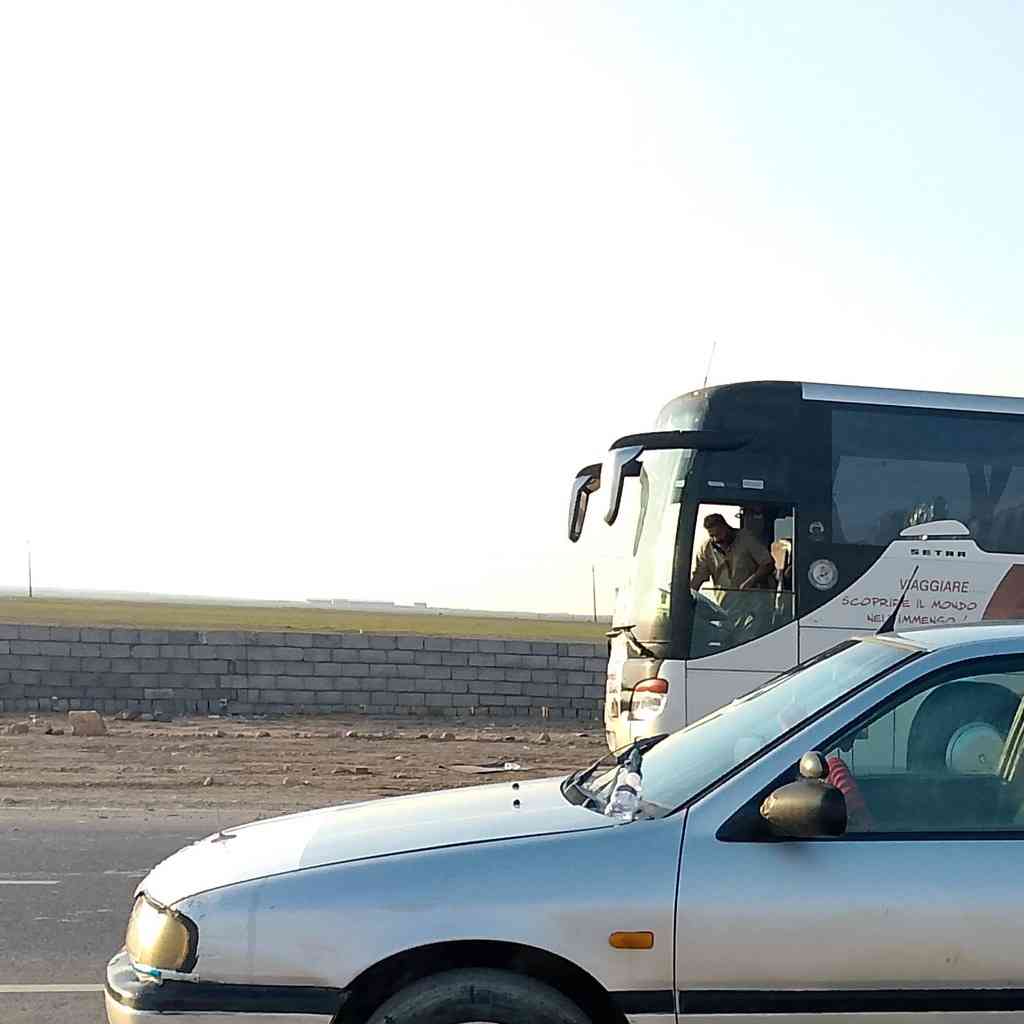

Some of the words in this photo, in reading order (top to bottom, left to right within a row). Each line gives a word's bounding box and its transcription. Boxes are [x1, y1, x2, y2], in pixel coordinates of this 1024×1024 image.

[910, 548, 966, 558] SETRA
[900, 578, 970, 593] VAGGIARE
[916, 599, 925, 609] IL
[931, 600, 977, 611] MONDO
